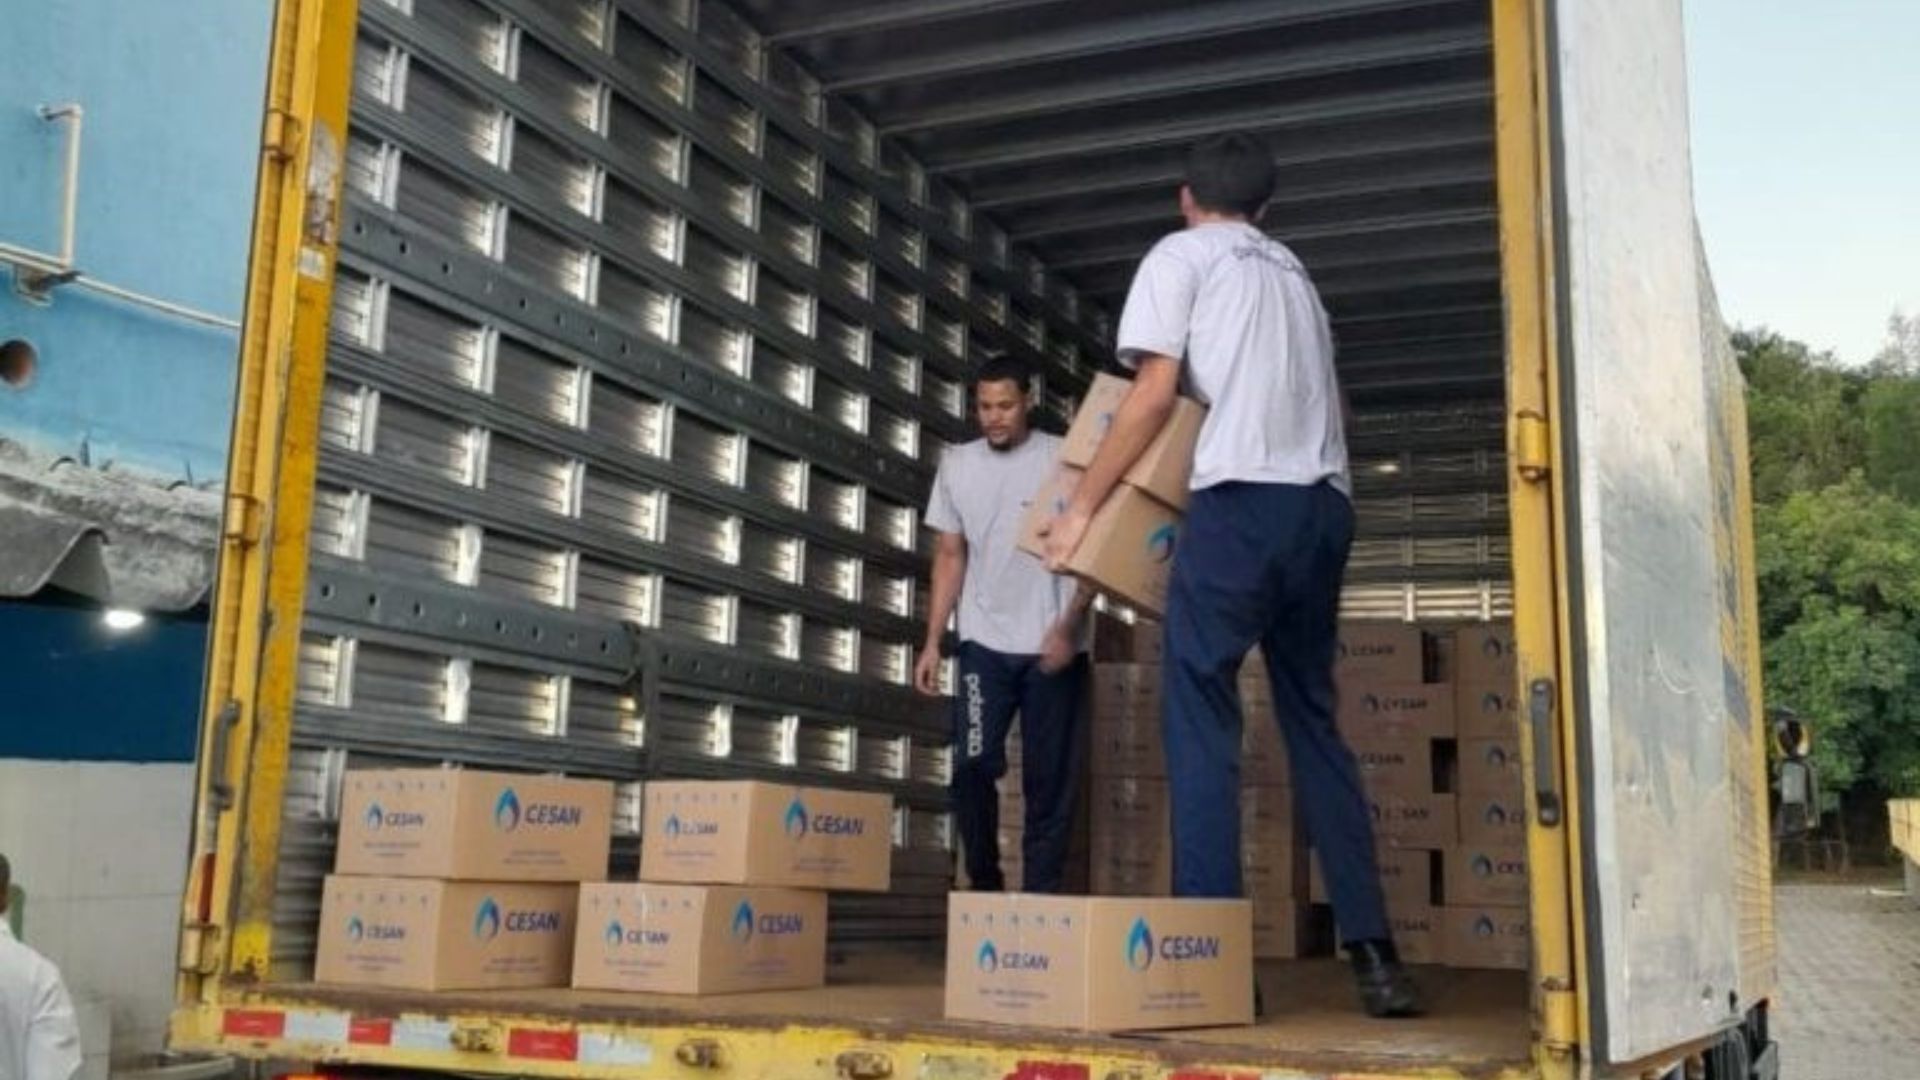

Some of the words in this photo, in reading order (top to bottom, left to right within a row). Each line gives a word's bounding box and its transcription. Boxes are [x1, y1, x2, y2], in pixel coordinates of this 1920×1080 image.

[385, 811, 425, 827] CESAN
[524, 804, 582, 827] CESAN
[811, 814, 864, 835] CESAN
[366, 924, 405, 940] CESAN
[504, 911, 561, 932] CESAN
[758, 912, 804, 934] CESAN
[1159, 935, 1220, 961] CESAN
[1001, 950, 1050, 971] CESAN
